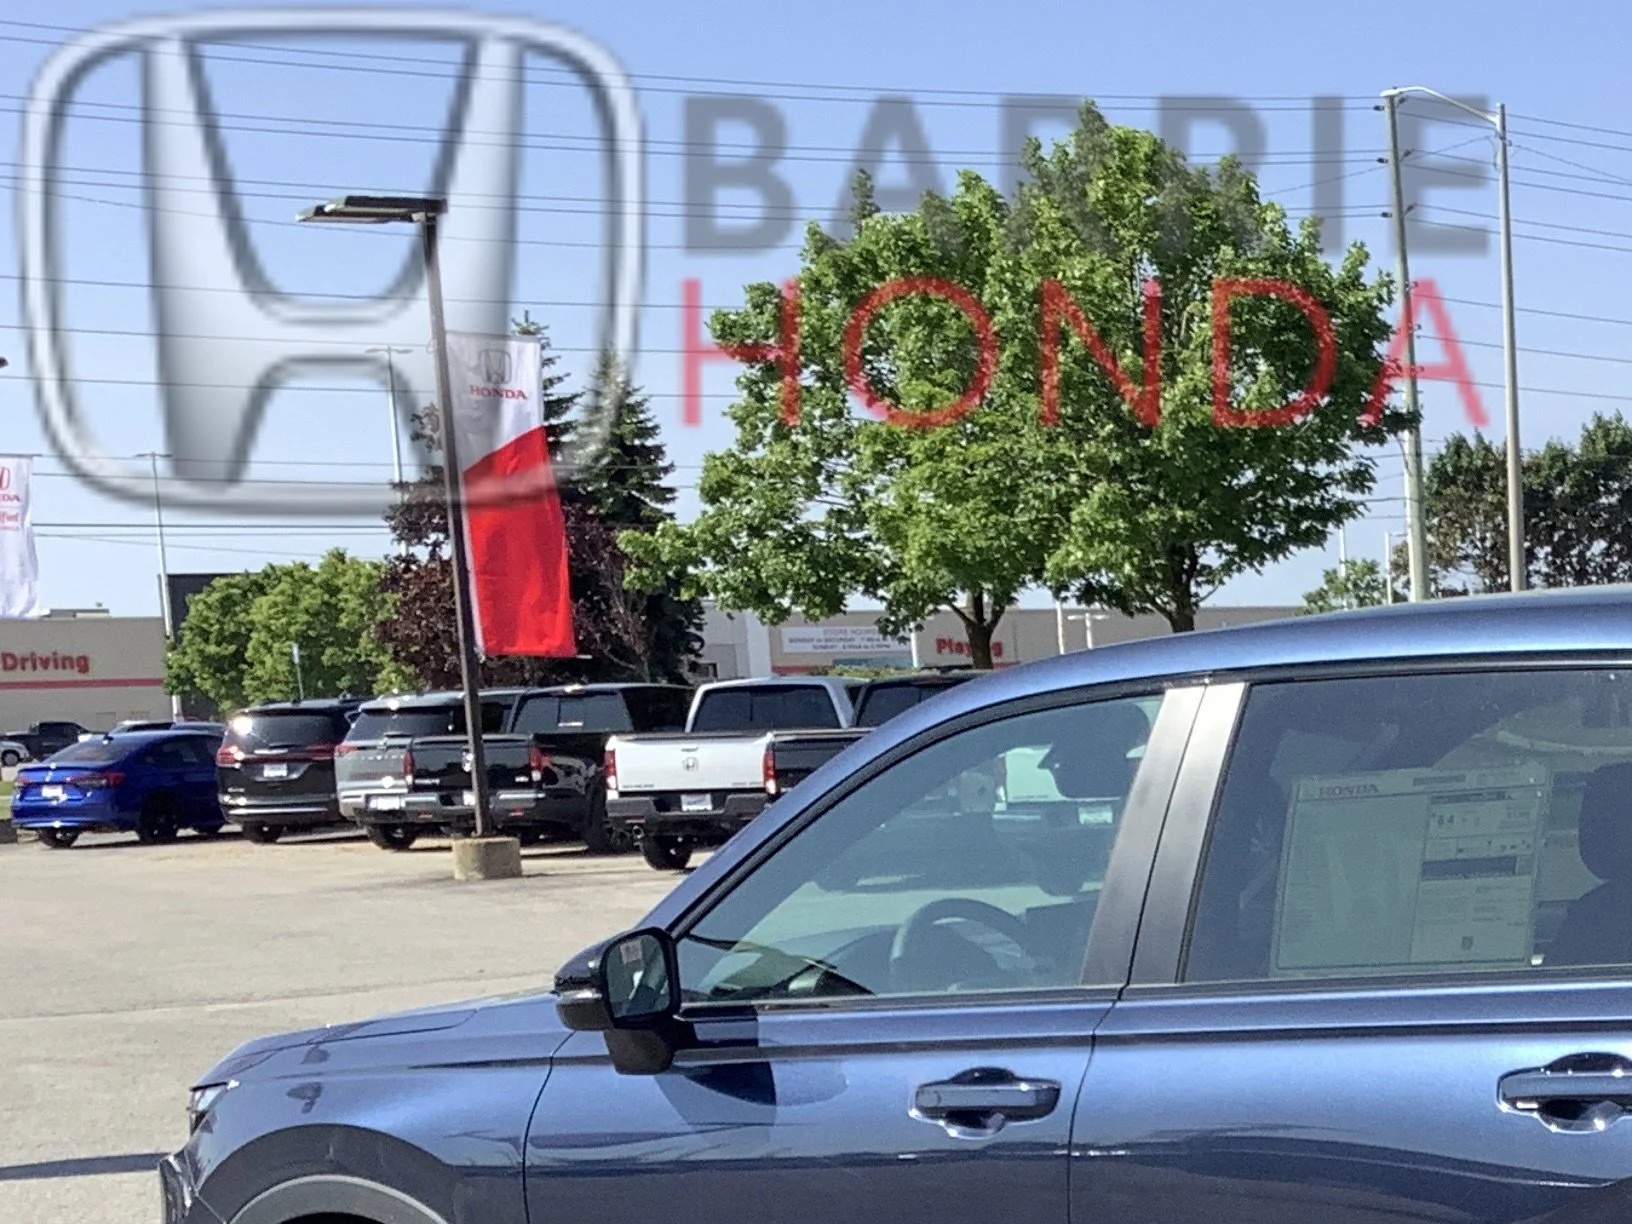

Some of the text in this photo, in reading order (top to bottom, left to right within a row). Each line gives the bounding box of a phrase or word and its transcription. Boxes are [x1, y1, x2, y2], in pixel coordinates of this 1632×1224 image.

[468, 384, 528, 400] HONDA
[935, 637, 1003, 658] Playg
[1, 651, 90, 674] Driving
[1319, 783, 1380, 798] HONDA
